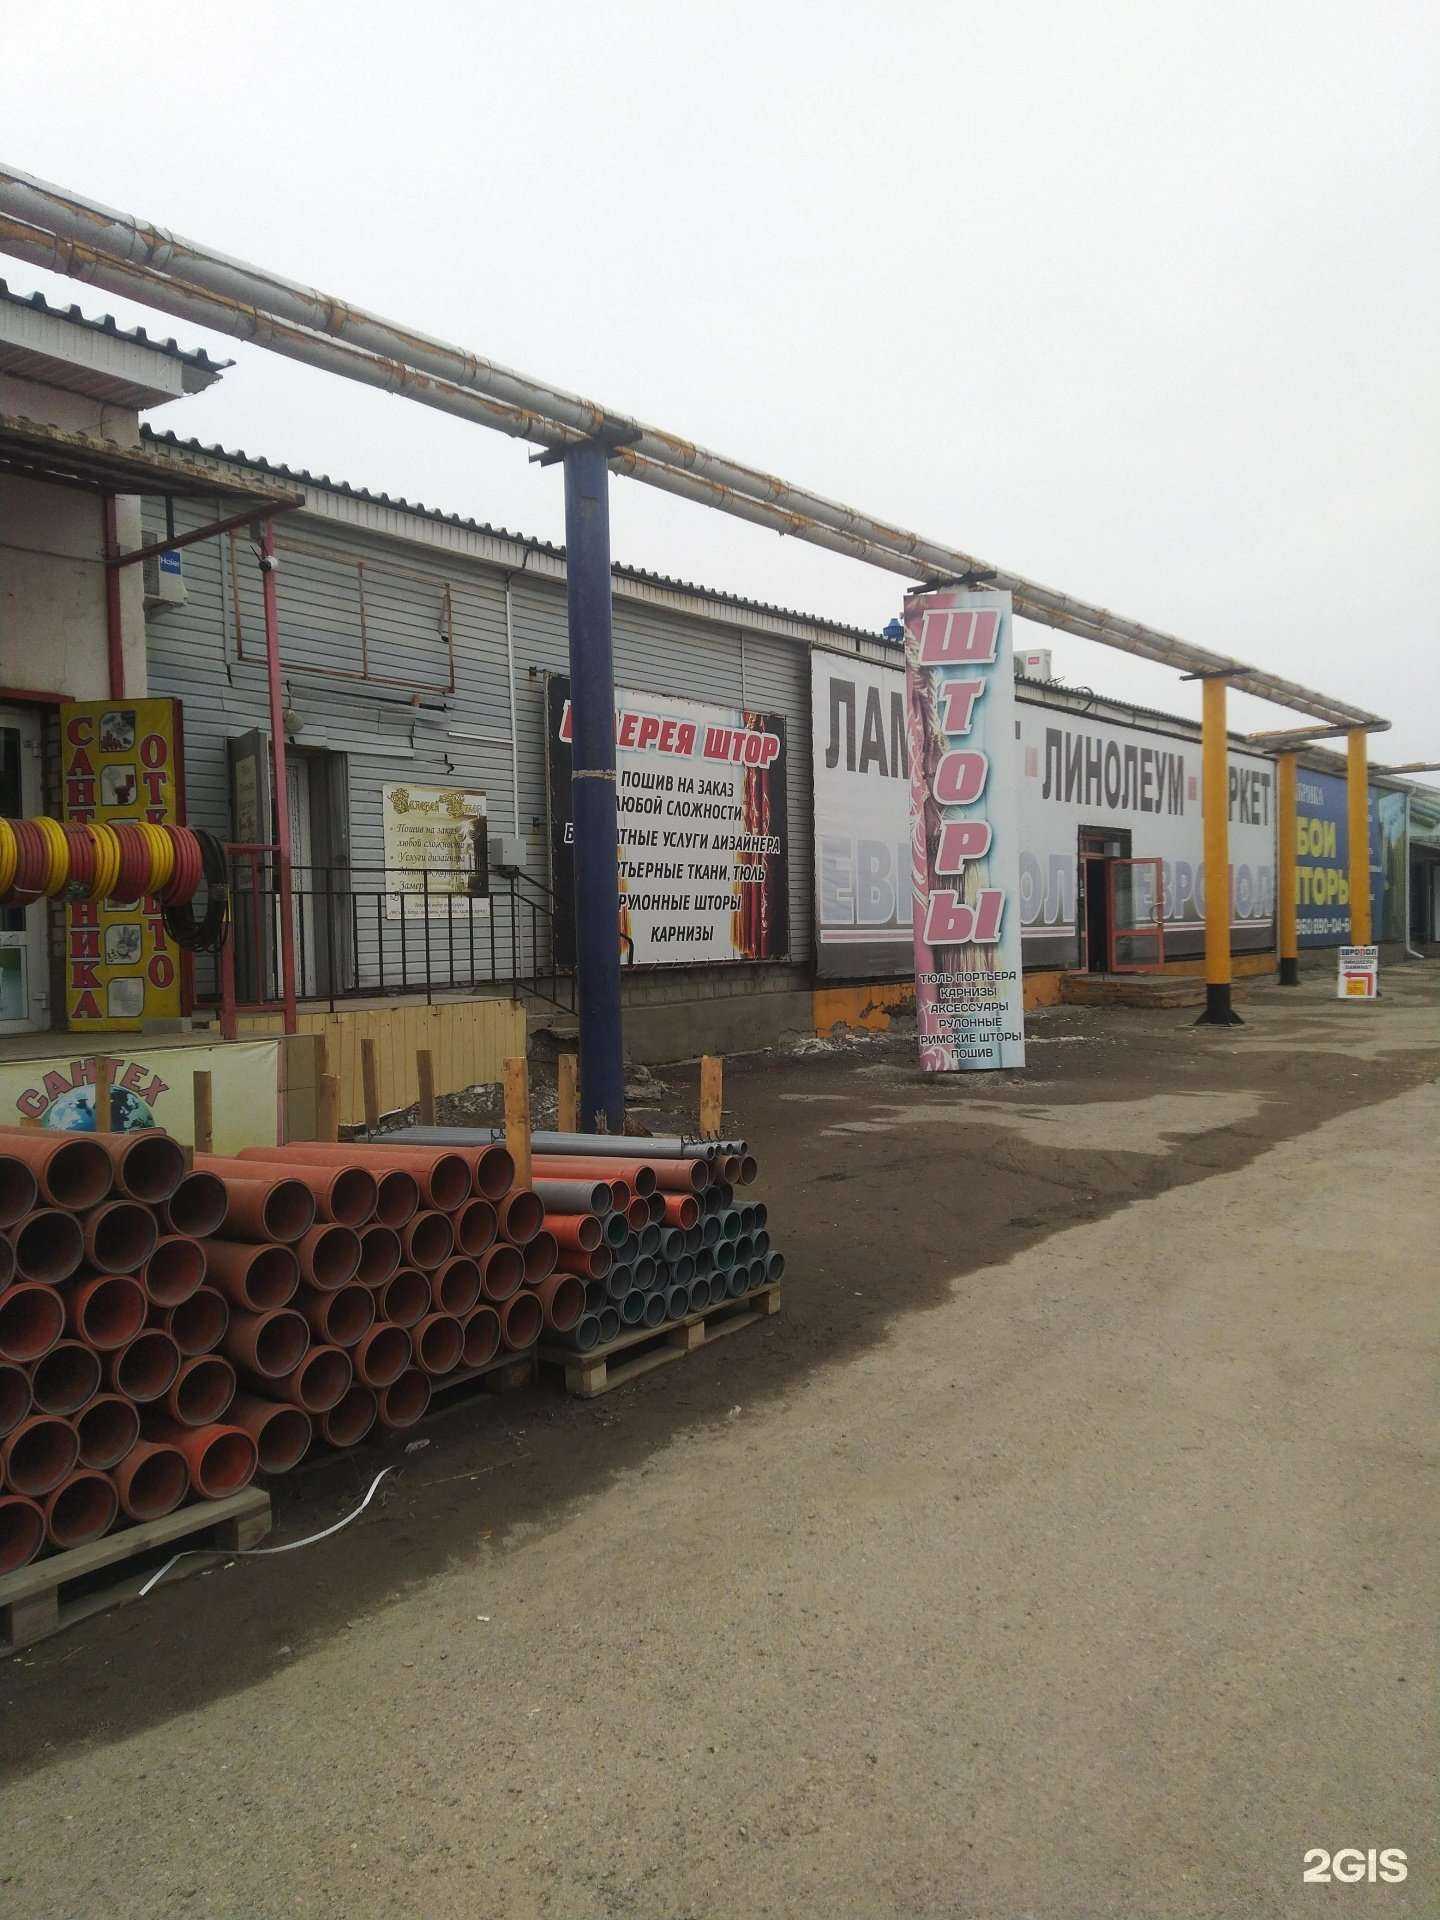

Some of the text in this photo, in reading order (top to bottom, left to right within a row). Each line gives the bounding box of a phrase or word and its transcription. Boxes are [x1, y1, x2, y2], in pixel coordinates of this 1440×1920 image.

[703, 726, 780, 767] ШТОР
[621, 771, 734, 798] ПОШИВ НА ЗАКАЗ
[920, 609, 1006, 945] ШТОРЫ
[1042, 727, 1185, 816] ЛИНОЛЕУМ
[1202, 766, 1271, 827] РКЕТ
[666, 800, 743, 821] СЛОЖНОСТИ
[663, 831, 709, 849] УСЛУГИ
[712, 834, 780, 853] ДИЗАЙНЕРА
[1296, 816, 1336, 858] БОИ
[687, 864, 730, 882] ТКАНИ,
[734, 865, 765, 881] ТЮЛЬ
[619, 894, 741, 911] РУЛОННЫЕ ШТОРЫ
[651, 925, 714, 942] КАРНИЗЫ
[920, 971, 1017, 984] ТЮЛЬ ПОРТЬЕРА
[940, 987, 997, 998] КАРНИЗЫ
[930, 1001, 1009, 1014] АКСЕССУАРЫ
[939, 1017, 1003, 1028] РУЛОННЫЕ
[920, 1031, 1022, 1045] РИМСКИЕ ШТОРЫ
[951, 1048, 993, 1059] ПОШИВ
